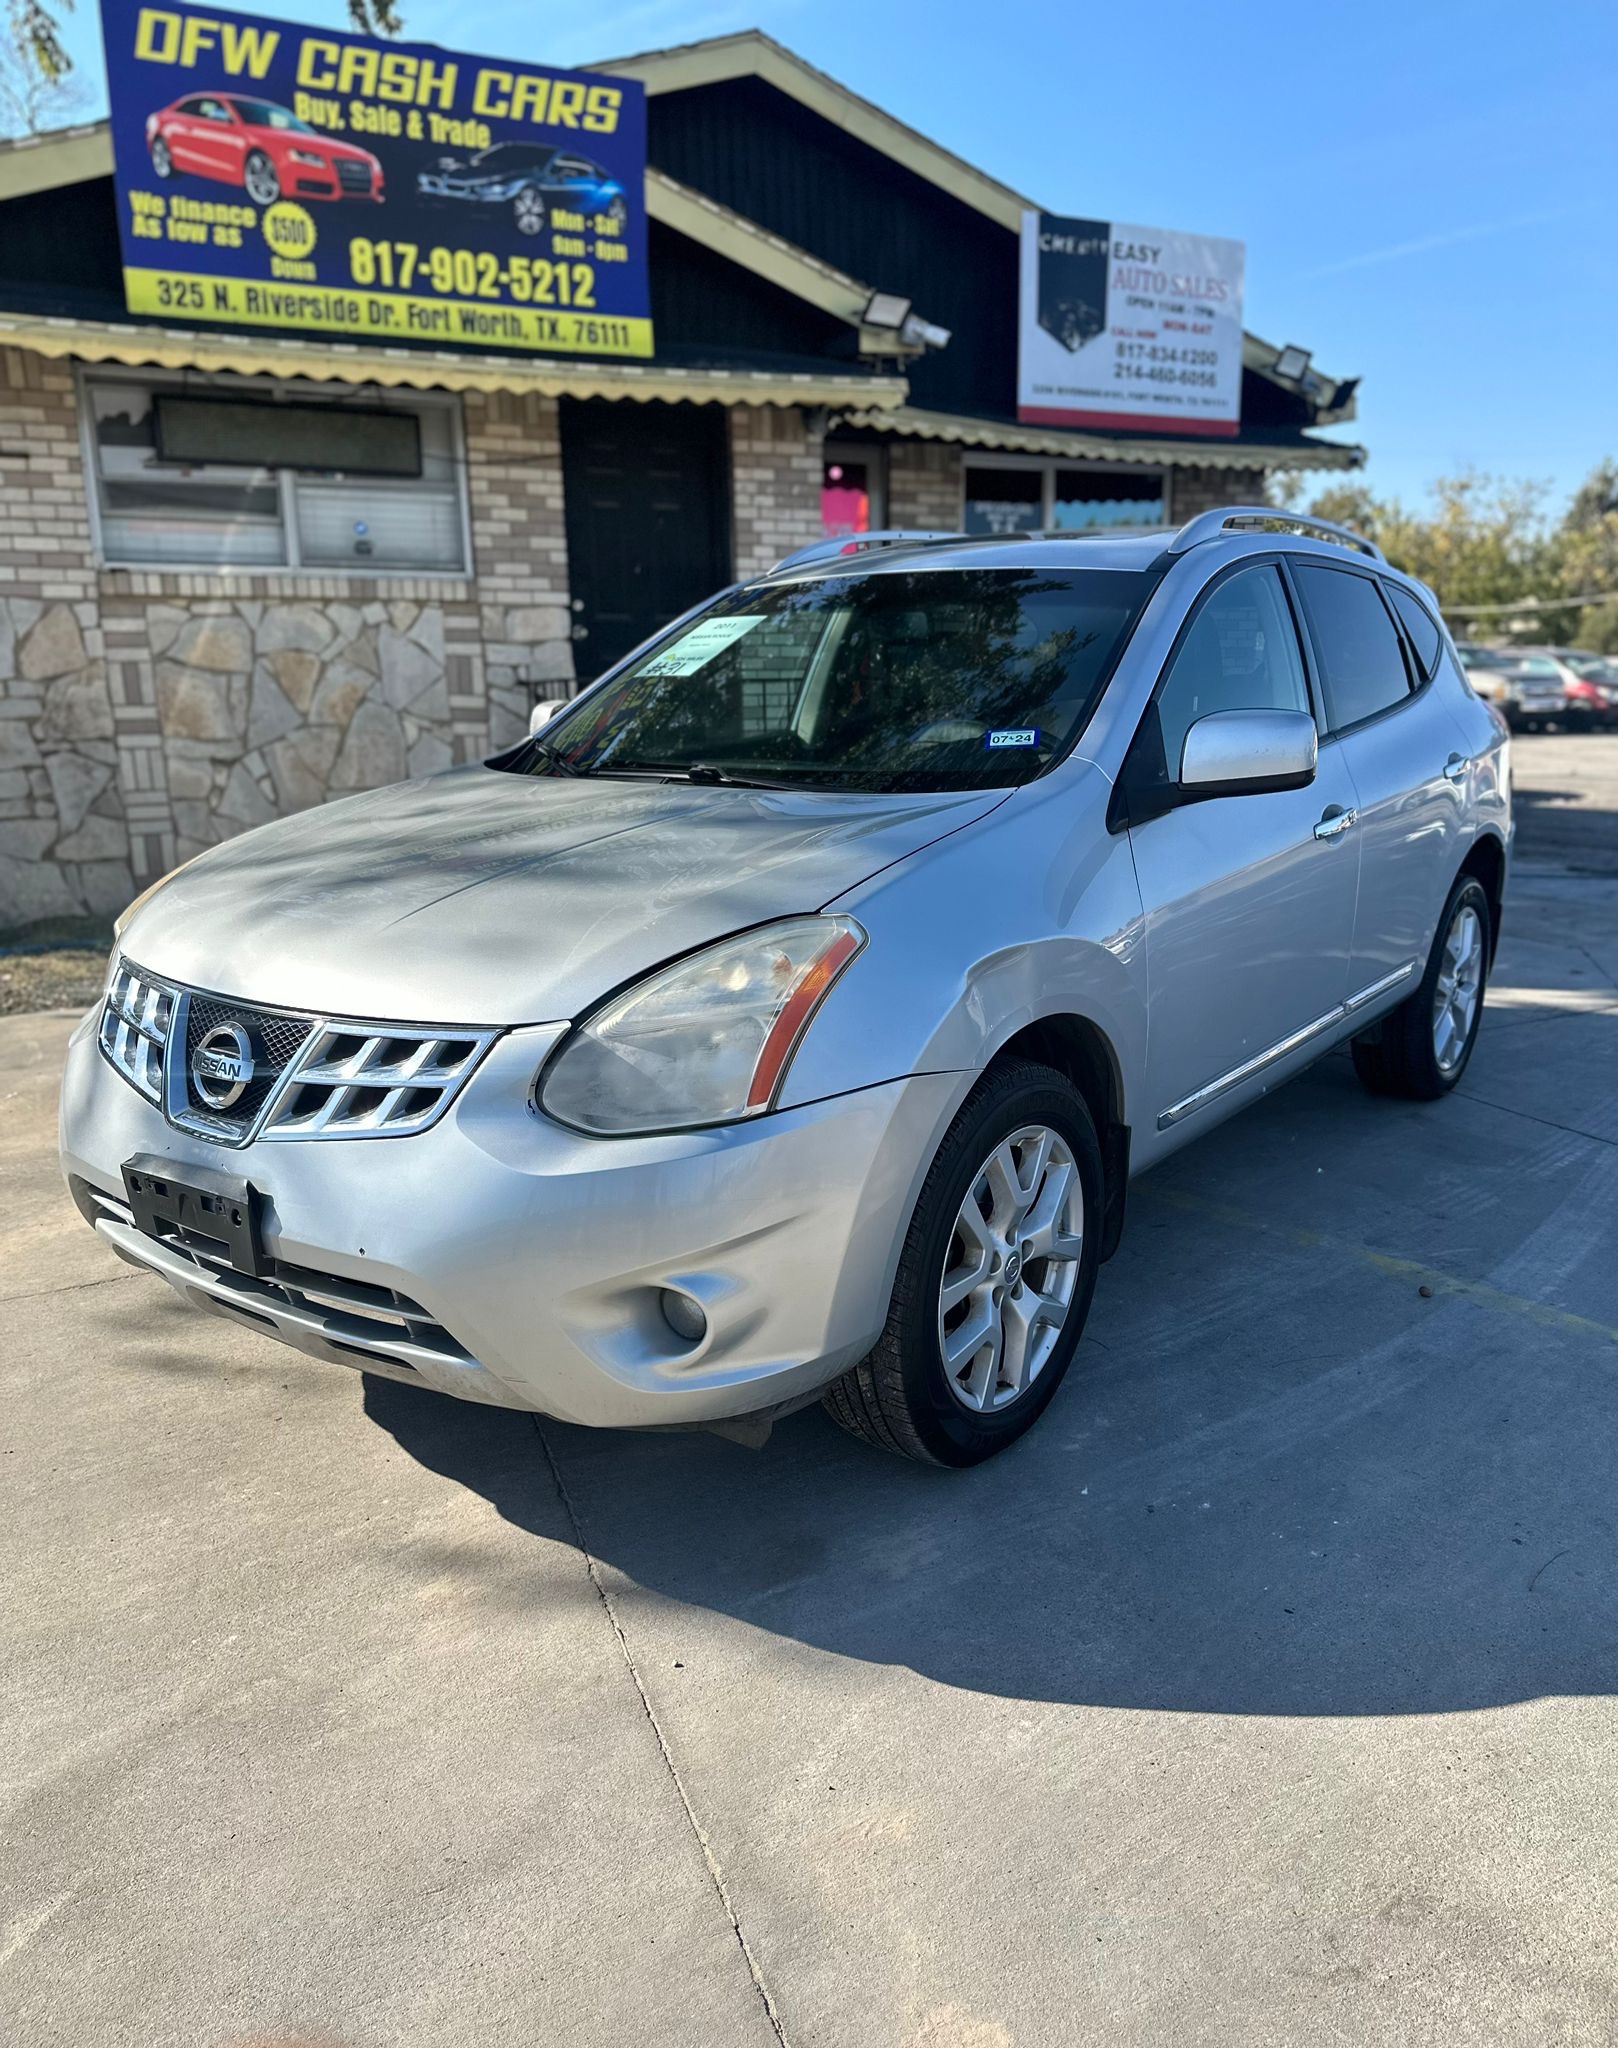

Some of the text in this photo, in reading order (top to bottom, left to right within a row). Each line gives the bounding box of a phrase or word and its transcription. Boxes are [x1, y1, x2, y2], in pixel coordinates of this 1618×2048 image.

[134, 8, 622, 134] DFW CASH CARS
[350, 99, 401, 137] Sale
[406, 111, 424, 141] &
[428, 113, 491, 150] Trade
[129, 190, 257, 229] We finance
[132, 215, 243, 248] As low as
[349, 237, 597, 308] 817-902-5212
[1113, 241, 1162, 263] EASY
[1113, 267, 1228, 302] AUTO SALES
[157, 279, 205, 309] 325
[212, 283, 238, 312] N.
[246, 287, 361, 323] Riverside
[367, 299, 400, 328] Dr.
[406, 304, 451, 333] Fort
[572, 320, 630, 349] 76111
